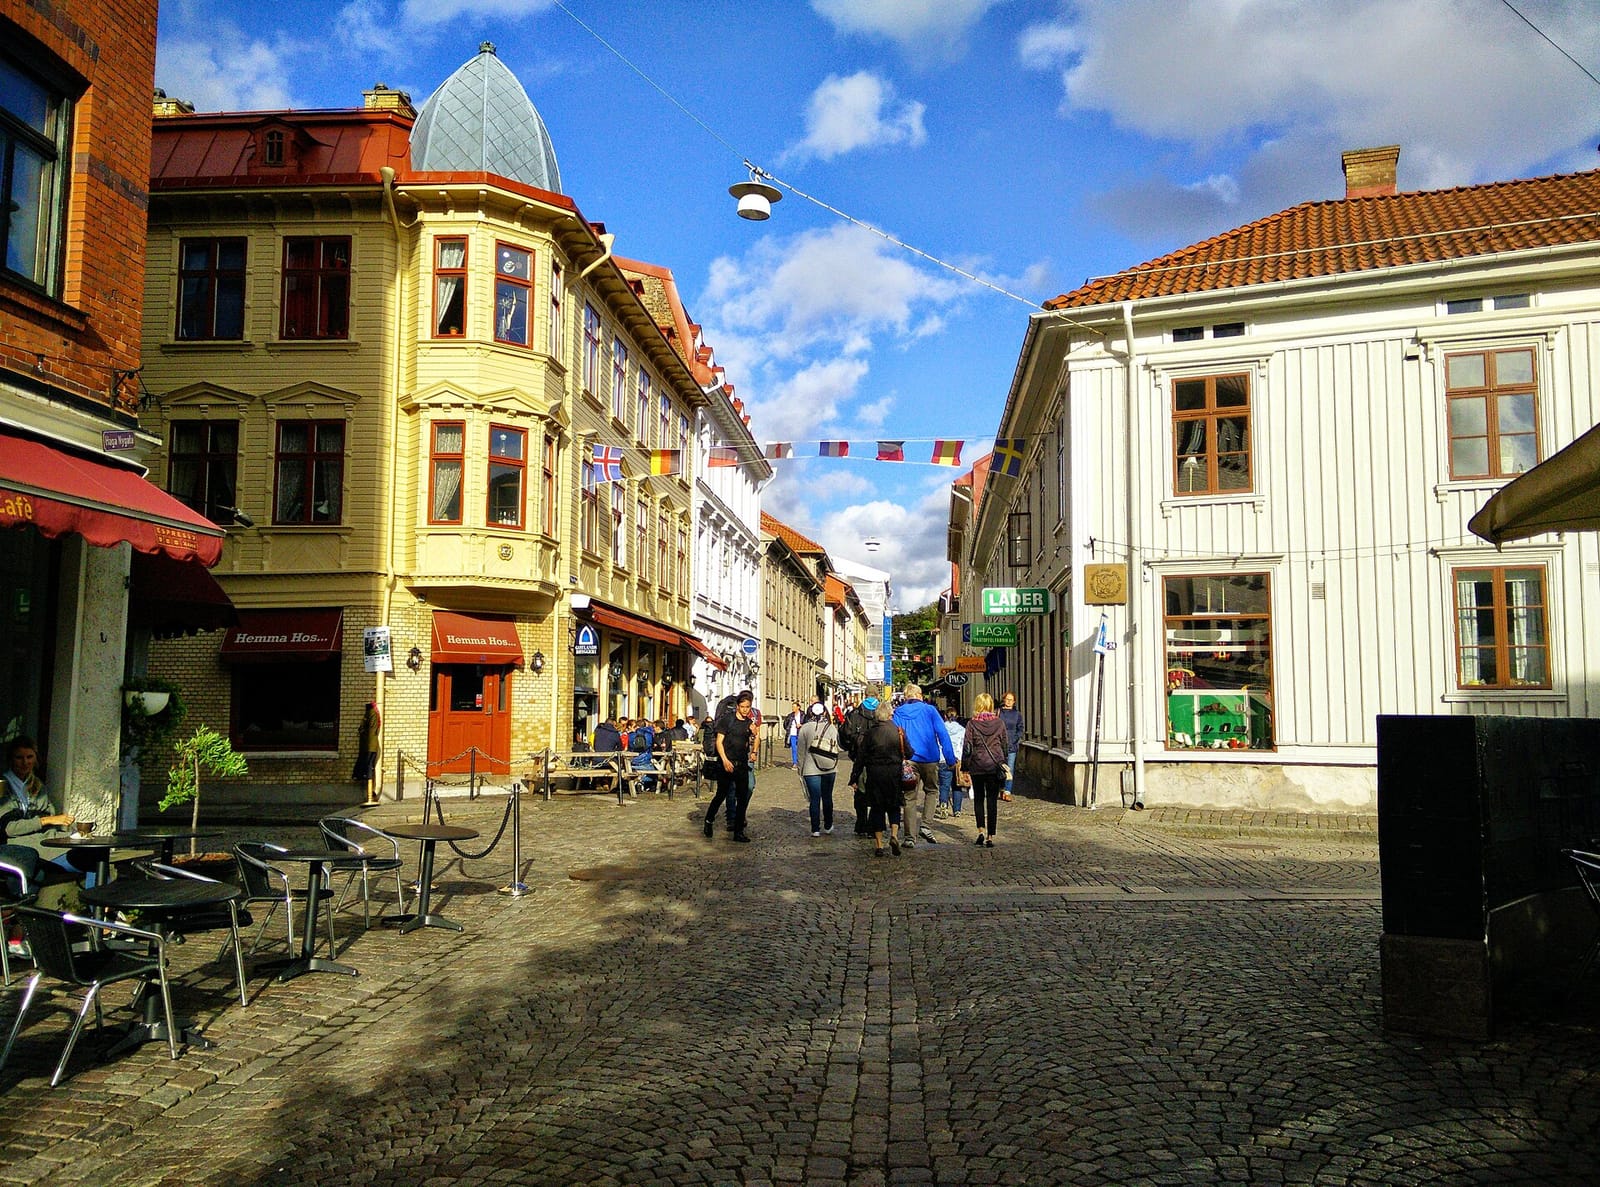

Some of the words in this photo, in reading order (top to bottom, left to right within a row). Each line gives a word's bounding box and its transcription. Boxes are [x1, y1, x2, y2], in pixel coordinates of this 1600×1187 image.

[976, 626, 1012, 637] HAGA
[234, 633, 288, 643] Hemma
[446, 634, 488, 646] Hemma
